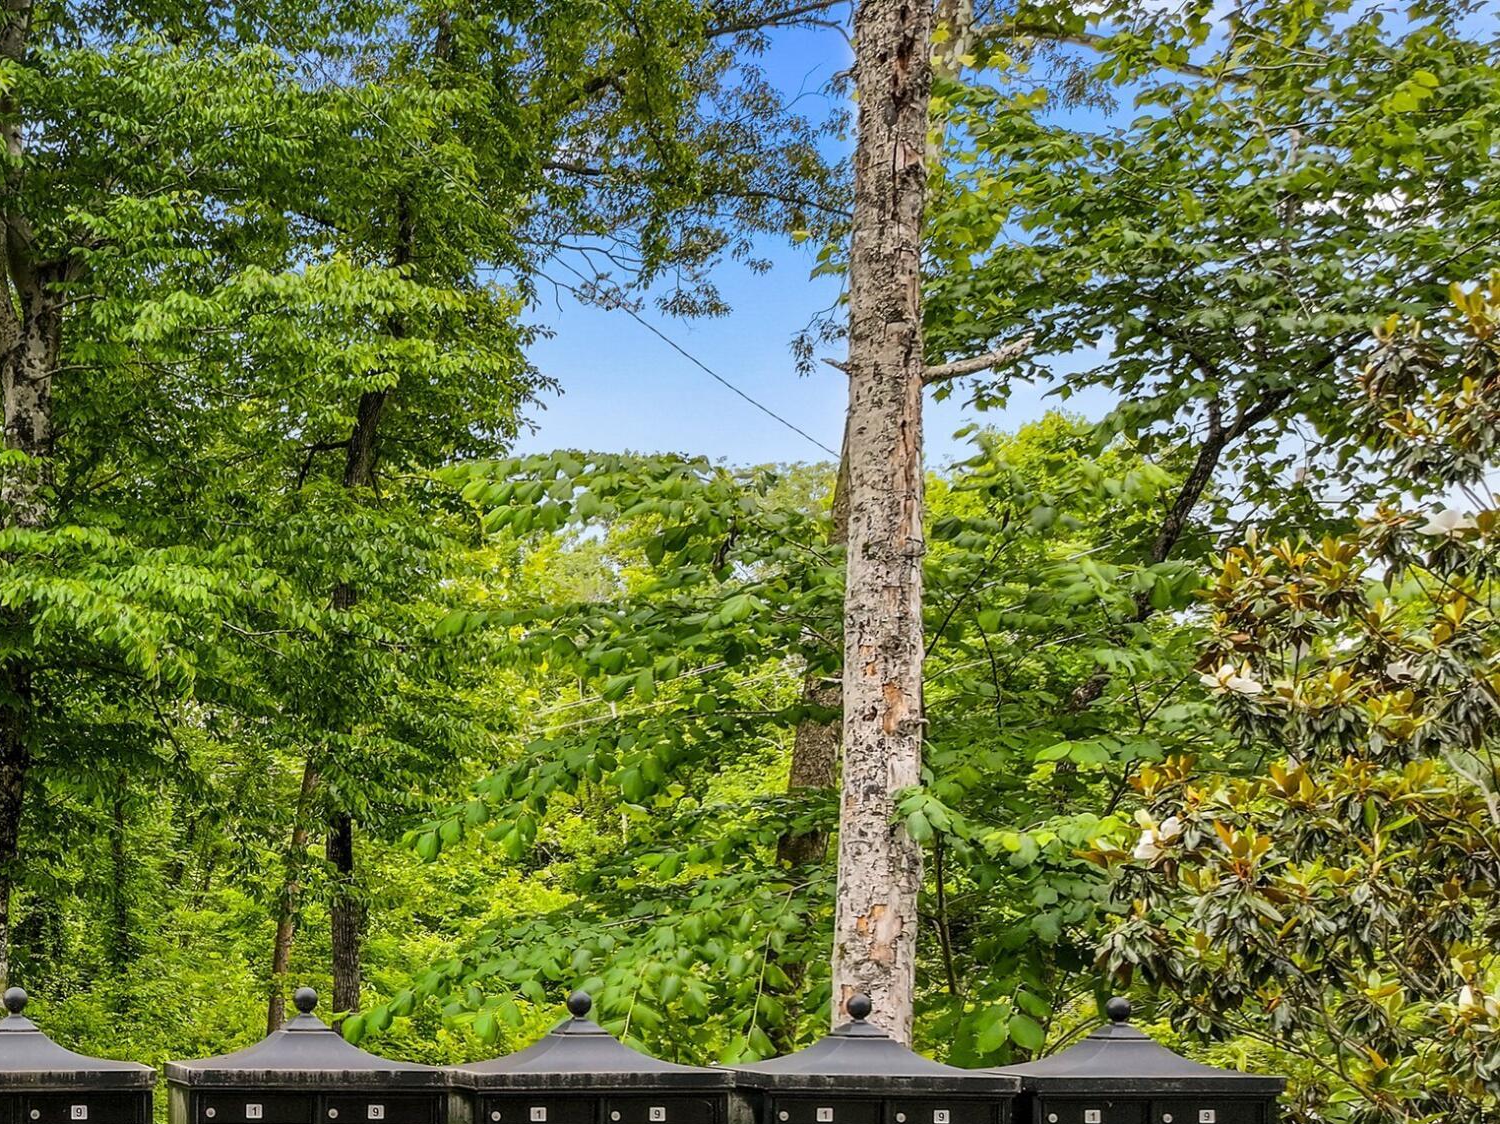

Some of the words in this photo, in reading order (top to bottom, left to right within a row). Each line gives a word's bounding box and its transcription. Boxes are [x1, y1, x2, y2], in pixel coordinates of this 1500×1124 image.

[75, 1107, 83, 1118] 9
[372, 1107, 380, 1117] 9
[653, 1109, 662, 1119] 9
[938, 1112, 946, 1122] 9
[1203, 1111, 1211, 1122] 9
